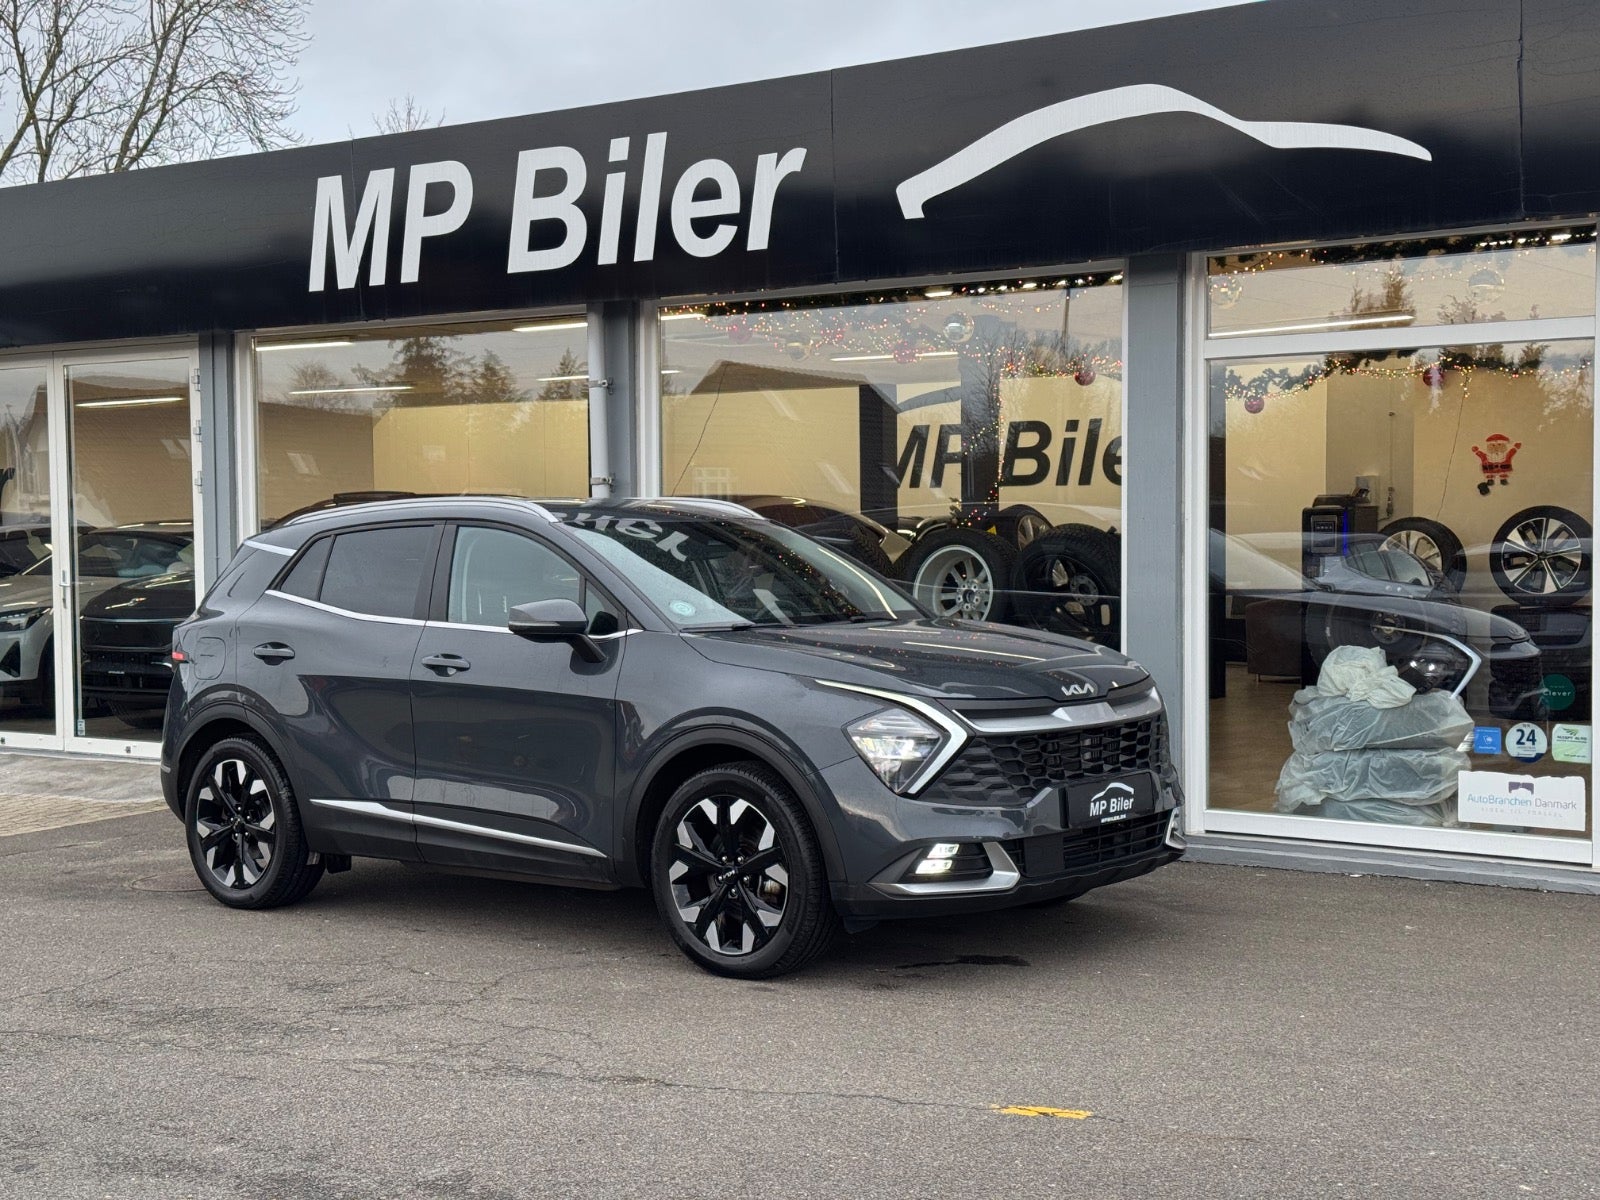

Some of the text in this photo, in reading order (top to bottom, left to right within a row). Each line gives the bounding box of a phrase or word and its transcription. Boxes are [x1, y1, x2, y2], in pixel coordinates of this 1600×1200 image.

[308, 131, 807, 293] MP Biler
[1516, 729, 1537, 746] 24
[1089, 796, 1134, 817] MP Biler
[1467, 793, 1577, 811] AutoBranchen Danmark
